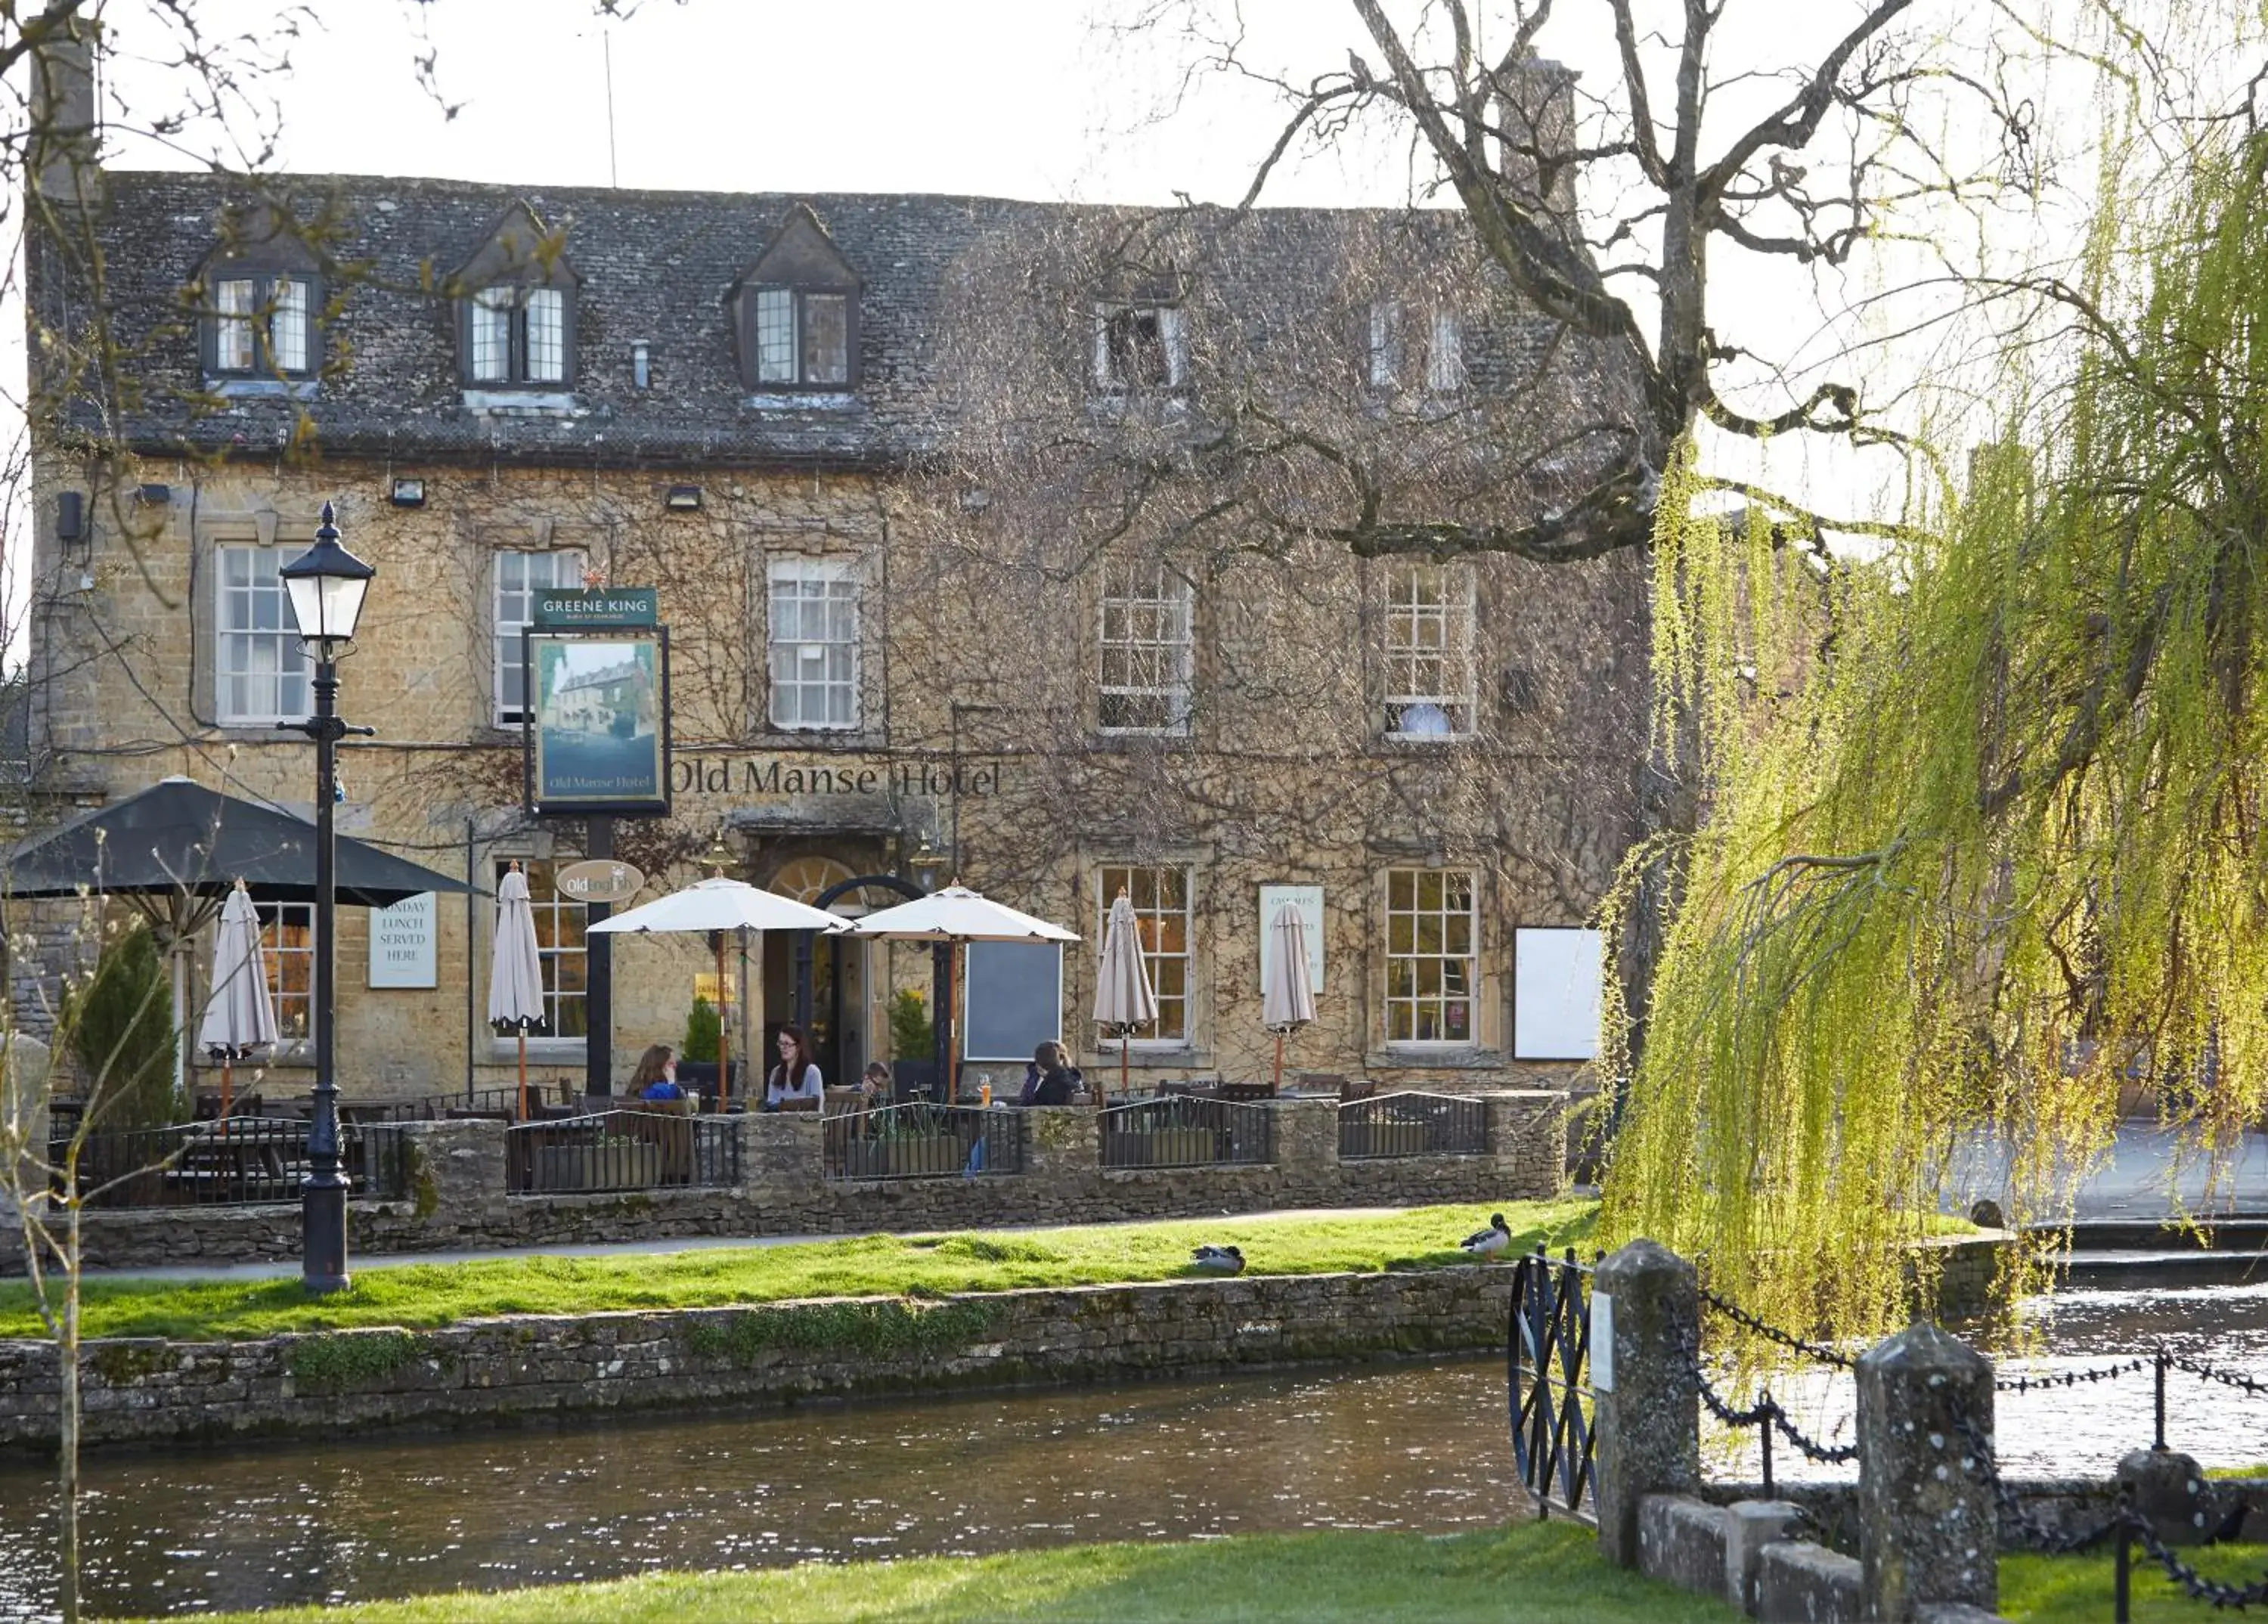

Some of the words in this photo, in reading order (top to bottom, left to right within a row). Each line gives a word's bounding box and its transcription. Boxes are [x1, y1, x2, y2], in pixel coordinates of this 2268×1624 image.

[544, 600, 603, 612] GREENE
[609, 600, 648, 612] KING
[670, 758, 733, 794] Old
[744, 761, 878, 795] Manse
[901, 761, 999, 795] Hotel
[382, 918, 424, 929] LUNCH
[380, 934, 426, 944] SERVED
[386, 949, 419, 962] HERE
